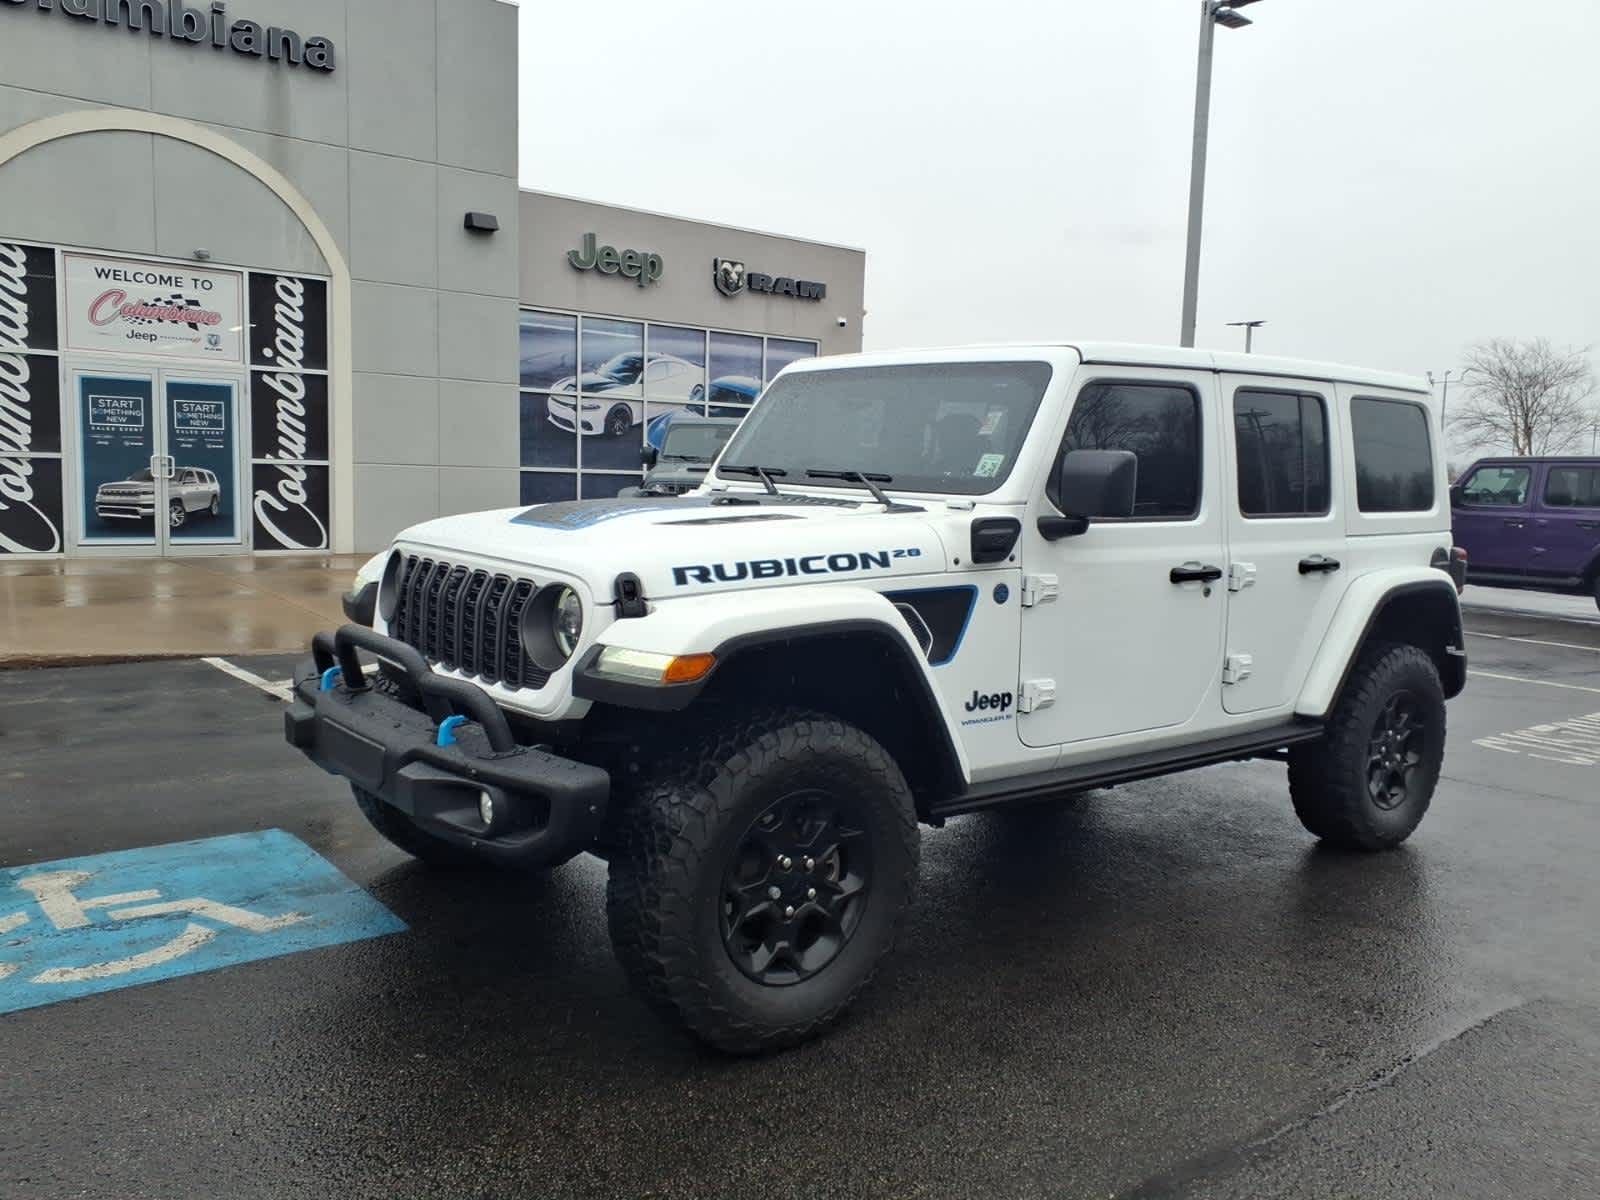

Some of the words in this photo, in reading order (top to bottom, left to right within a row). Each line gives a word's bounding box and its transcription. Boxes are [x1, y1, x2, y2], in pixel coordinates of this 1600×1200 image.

[567, 232, 664, 288] Jeep
[94, 267, 183, 288] WELCOME
[191, 278, 213, 291] TO
[747, 271, 827, 299] RAM
[126, 329, 158, 342] Jeep
[98, 399, 135, 409] START
[182, 403, 216, 413] START
[254, 276, 327, 550] Columbiana
[106, 415, 128, 424] NEW
[190, 419, 209, 427] NEW
[672, 550, 891, 586] RUBICON
[965, 690, 1013, 712] Jeep
